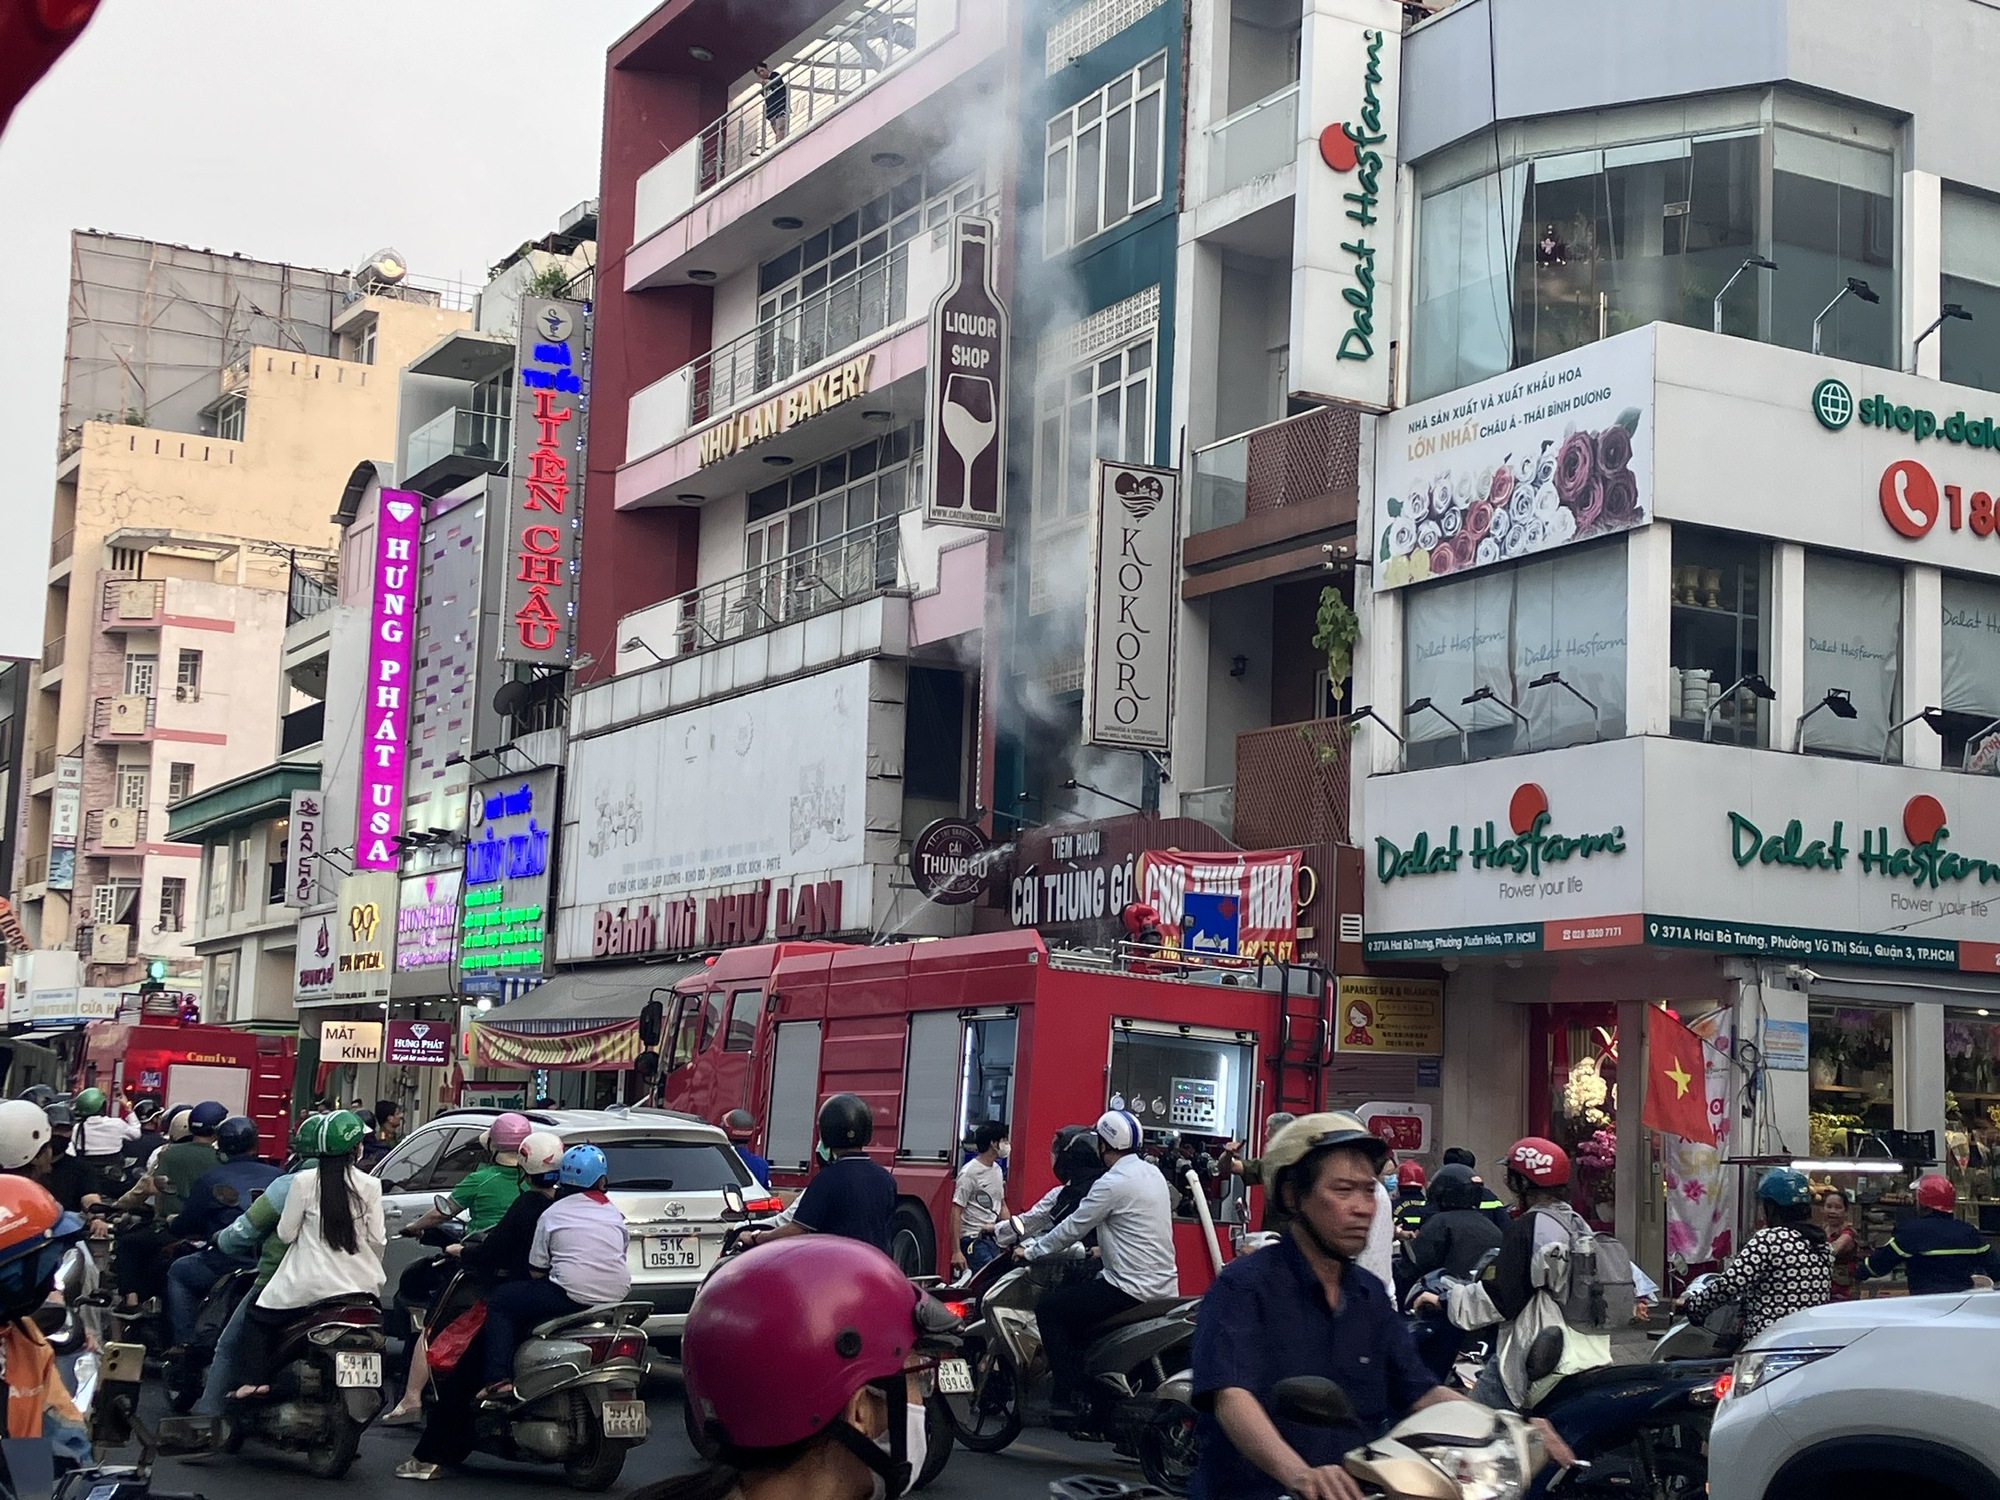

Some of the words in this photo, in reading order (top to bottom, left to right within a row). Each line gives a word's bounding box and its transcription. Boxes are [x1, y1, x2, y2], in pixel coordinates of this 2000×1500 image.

[1343, 31, 1387, 226] Hasfarm
[1336, 239, 1376, 361] Dalat
[946, 311, 997, 338] LIQUOR
[951, 344, 989, 369] SHOP
[699, 411, 739, 468] NHƯ
[740, 399, 782, 449] LAN
[787, 354, 875, 428] BAKERY
[1408, 418, 1428, 434] NHÀ
[1431, 410, 1450, 427] SẢN
[1452, 400, 1477, 420] XUẤT
[1481, 394, 1494, 411] VÀ
[1498, 383, 1524, 404] XUẤT
[1527, 371, 1555, 395] KHẨU
[1558, 367, 1582, 384] HOA
[1408, 433, 1436, 461] LỚN
[1440, 418, 1480, 450] NHẤT
[1480, 420, 1506, 438] CHÂU
[1509, 417, 1517, 429] Á
[1524, 406, 1545, 424] THÁI
[1548, 398, 1570, 416] BÌNH
[1573, 387, 1611, 409] DƯƠNG
[525, 390, 570, 513] LIÊN
[381, 537, 409, 642] HƯNG
[515, 525, 563, 649] CHÂU
[1114, 527, 1152, 724] KOKORO
[1942, 606, 1981, 629] Dalat
[1524, 646, 1560, 667] Dalat
[1566, 632, 1627, 657] Hasfarm
[374, 660, 401, 767] PHÁT
[366, 784, 393, 861] USA
[1727, 811, 1849, 868] Dalat
[949, 840, 962, 853] CÁI
[1052, 832, 1073, 862] TIỆM
[1375, 825, 1463, 884] Dalat
[1469, 812, 1626, 876] Hasfarm
[1011, 864, 1039, 926] CÁI
[1044, 861, 1105, 922] THÙNG
[1248, 855, 1294, 928] NHÀ
[1500, 881, 1535, 898] Flower
[1538, 880, 1565, 899] your
[1567, 876, 1583, 894] life
[1891, 893, 1933, 913] Flower
[1938, 897, 1966, 917] your
[1969, 896, 1988, 918] life
[592, 905, 656, 957] Bánh
[665, 898, 696, 948] Mì
[705, 878, 771, 944] NHƯ
[775, 879, 843, 938] LAN
[1605, 926, 1621, 937] 7171
[1516, 931, 1536, 943] HCM
[1662, 925, 1691, 940] 371A
[1694, 928, 1714, 942] Hai
[1716, 929, 1731, 943] Bà
[1734, 932, 1768, 949] Trưng,
[1771, 934, 1812, 953] Phường
[1814, 937, 1829, 950] Võ
[1831, 940, 1847, 956] Thị
[1849, 940, 1872, 957] Sáu,
[1874, 944, 1903, 960] Quận
[1905, 947, 1915, 960] 3,
[1917, 947, 1955, 962] TP.HCM
[80, 996, 103, 1015] CỬA
[1342, 984, 1378, 995] JAPANESE
[1380, 985, 1394, 996] SPA
[342, 1043, 377, 1059] KÍNH
[422, 1039, 444, 1049] PHÁT
[651, 1252, 694, 1265] 069.78
[660, 1238, 684, 1251] 51K
